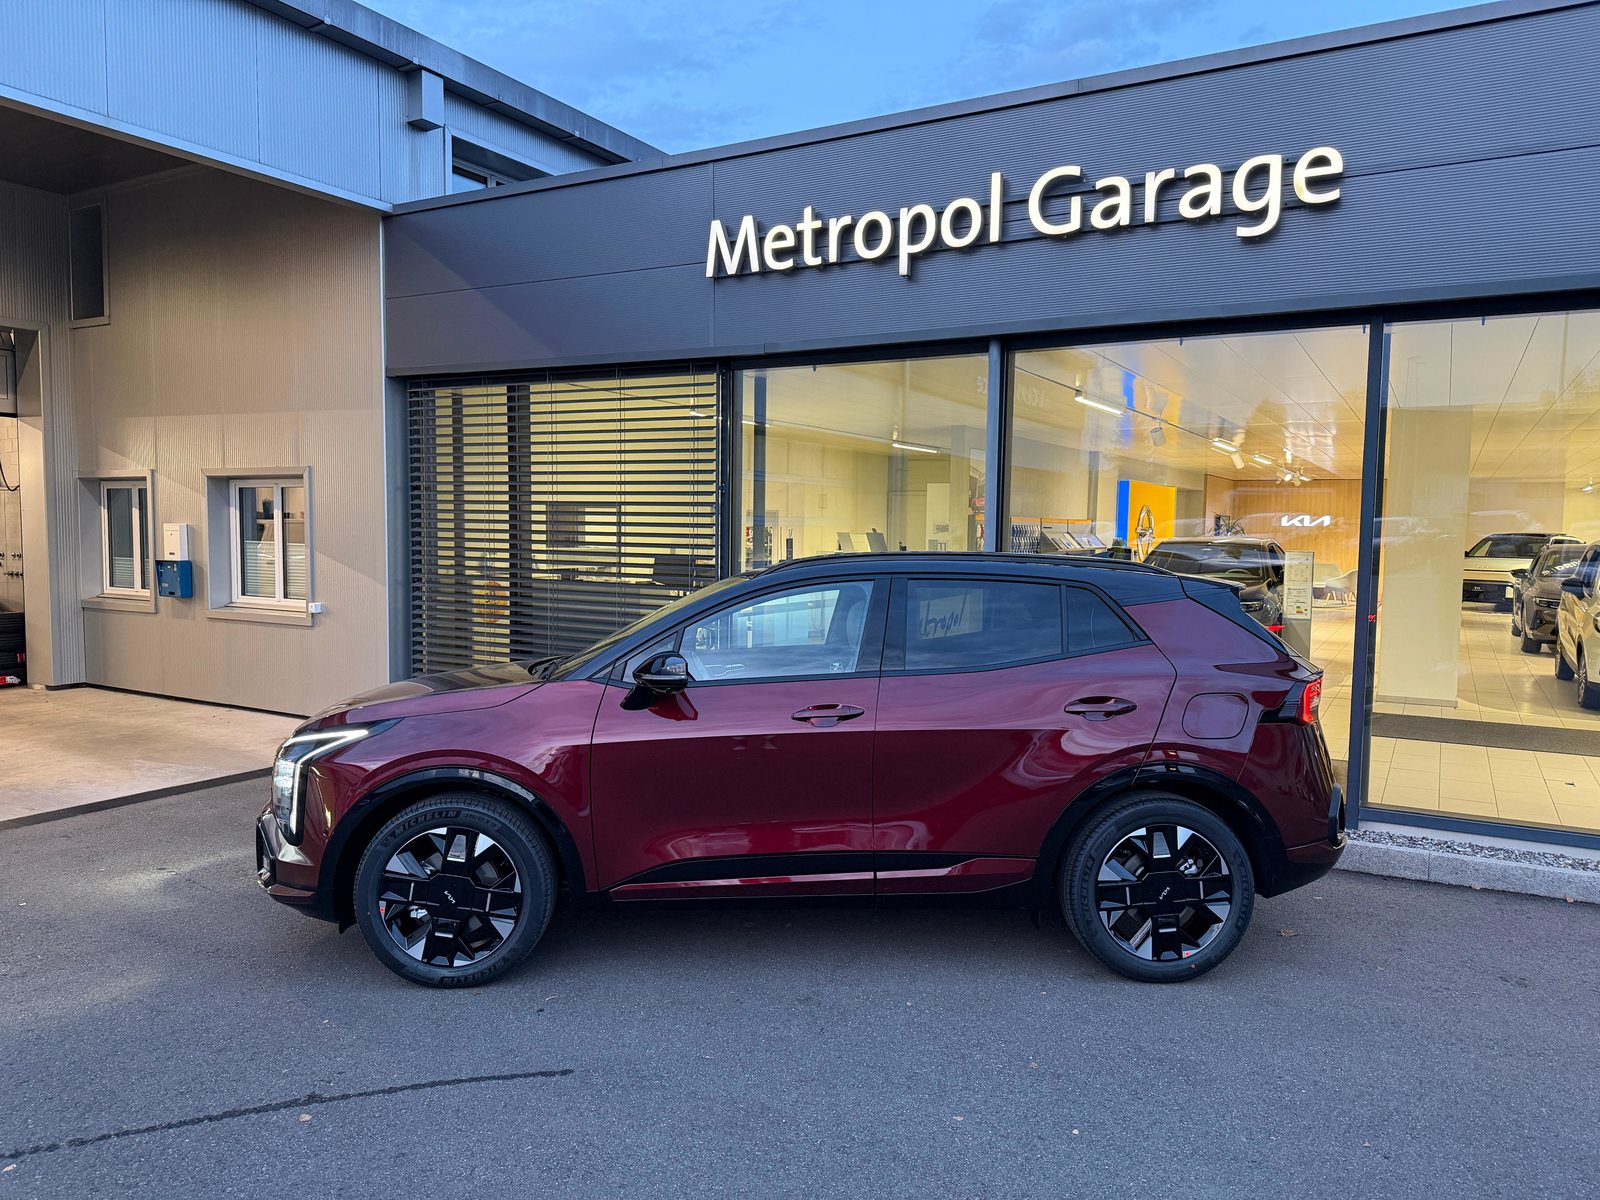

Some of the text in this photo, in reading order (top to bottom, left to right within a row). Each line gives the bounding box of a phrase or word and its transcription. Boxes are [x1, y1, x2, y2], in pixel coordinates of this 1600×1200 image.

[705, 145, 1345, 277] Metropol Garage
[1281, 515, 1331, 527] KIA
[394, 810, 459, 837] MICHELIN
